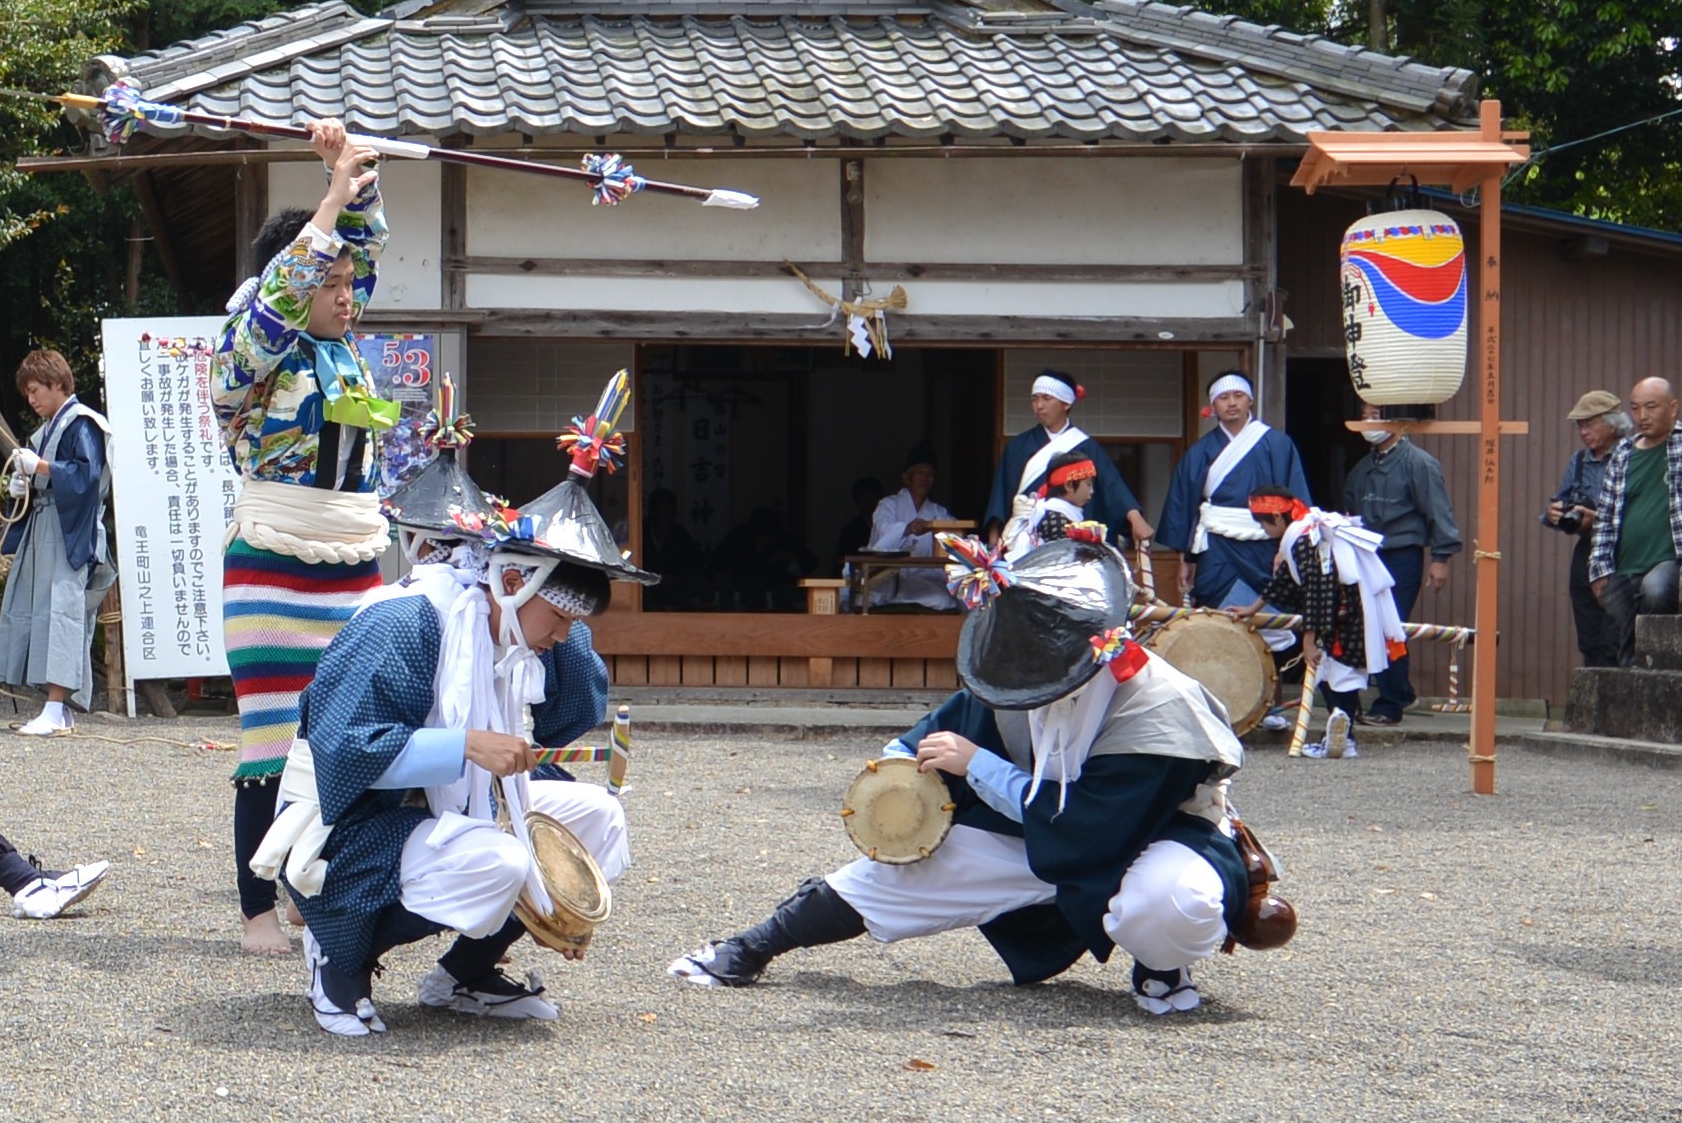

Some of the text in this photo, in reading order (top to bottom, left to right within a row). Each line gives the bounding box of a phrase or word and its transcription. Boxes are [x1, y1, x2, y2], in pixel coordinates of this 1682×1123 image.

[135, 525, 156, 660] 竜王町山之上連合区
